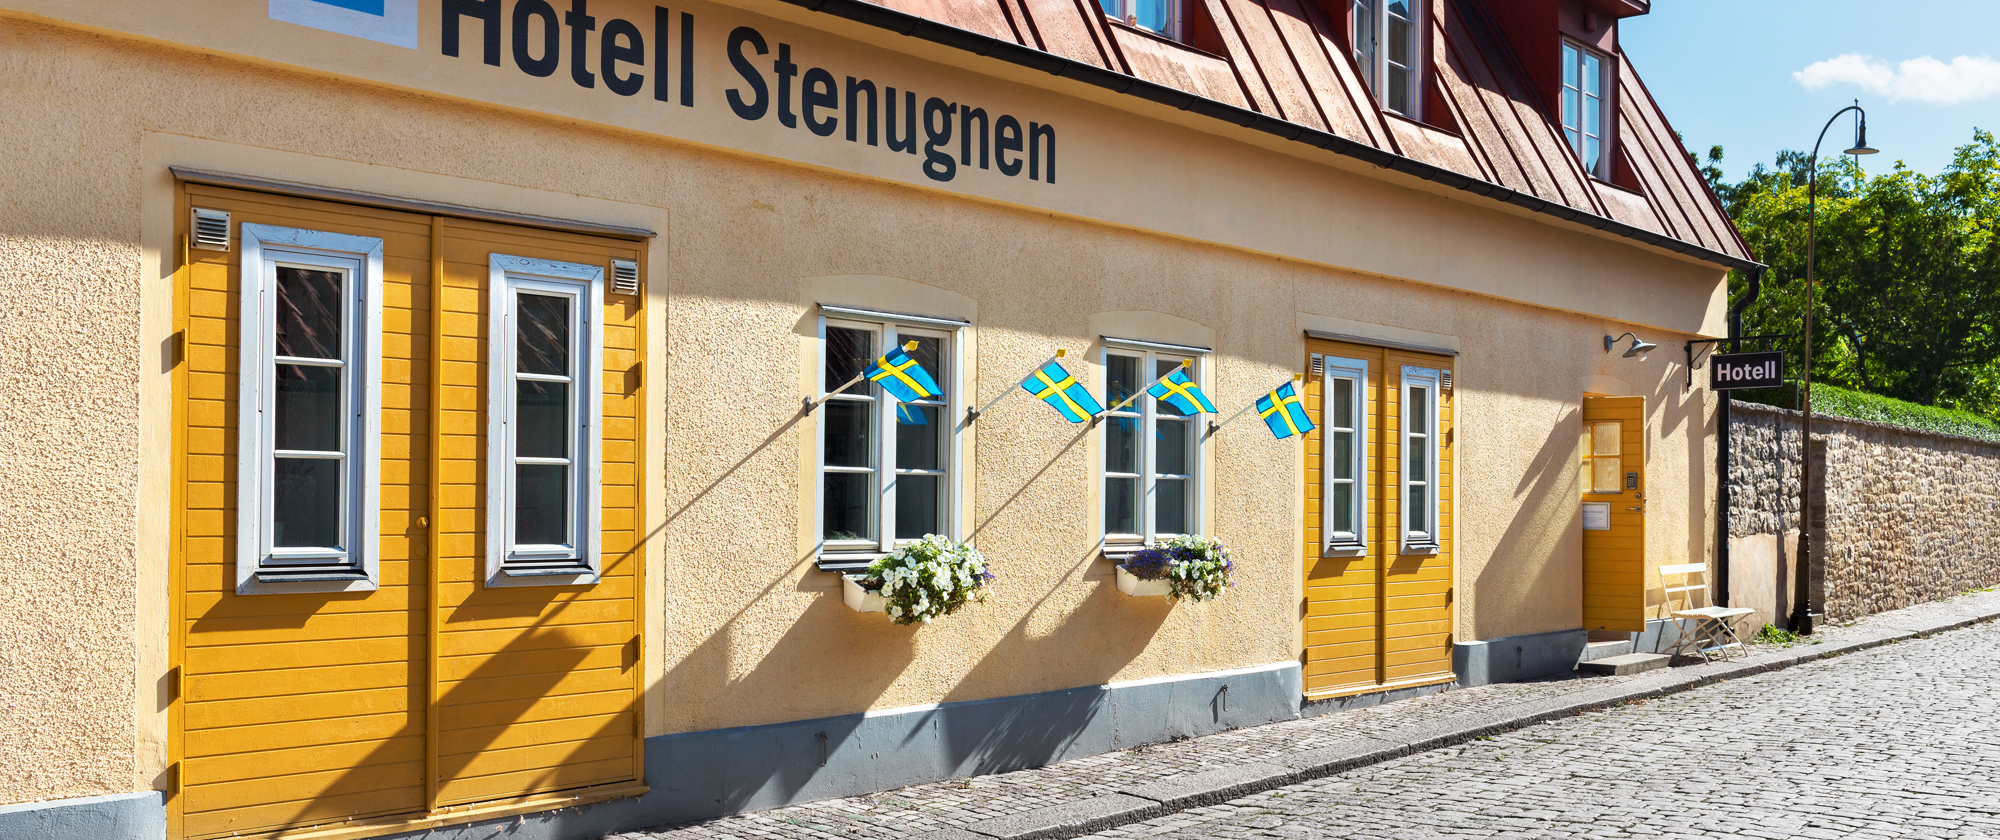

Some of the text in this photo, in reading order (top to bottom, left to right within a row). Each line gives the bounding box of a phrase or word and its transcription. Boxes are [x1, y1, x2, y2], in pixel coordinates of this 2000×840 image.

[441, 0, 1056, 183] Hotell Stenugnen
[1717, 360, 1776, 382] Hotell
